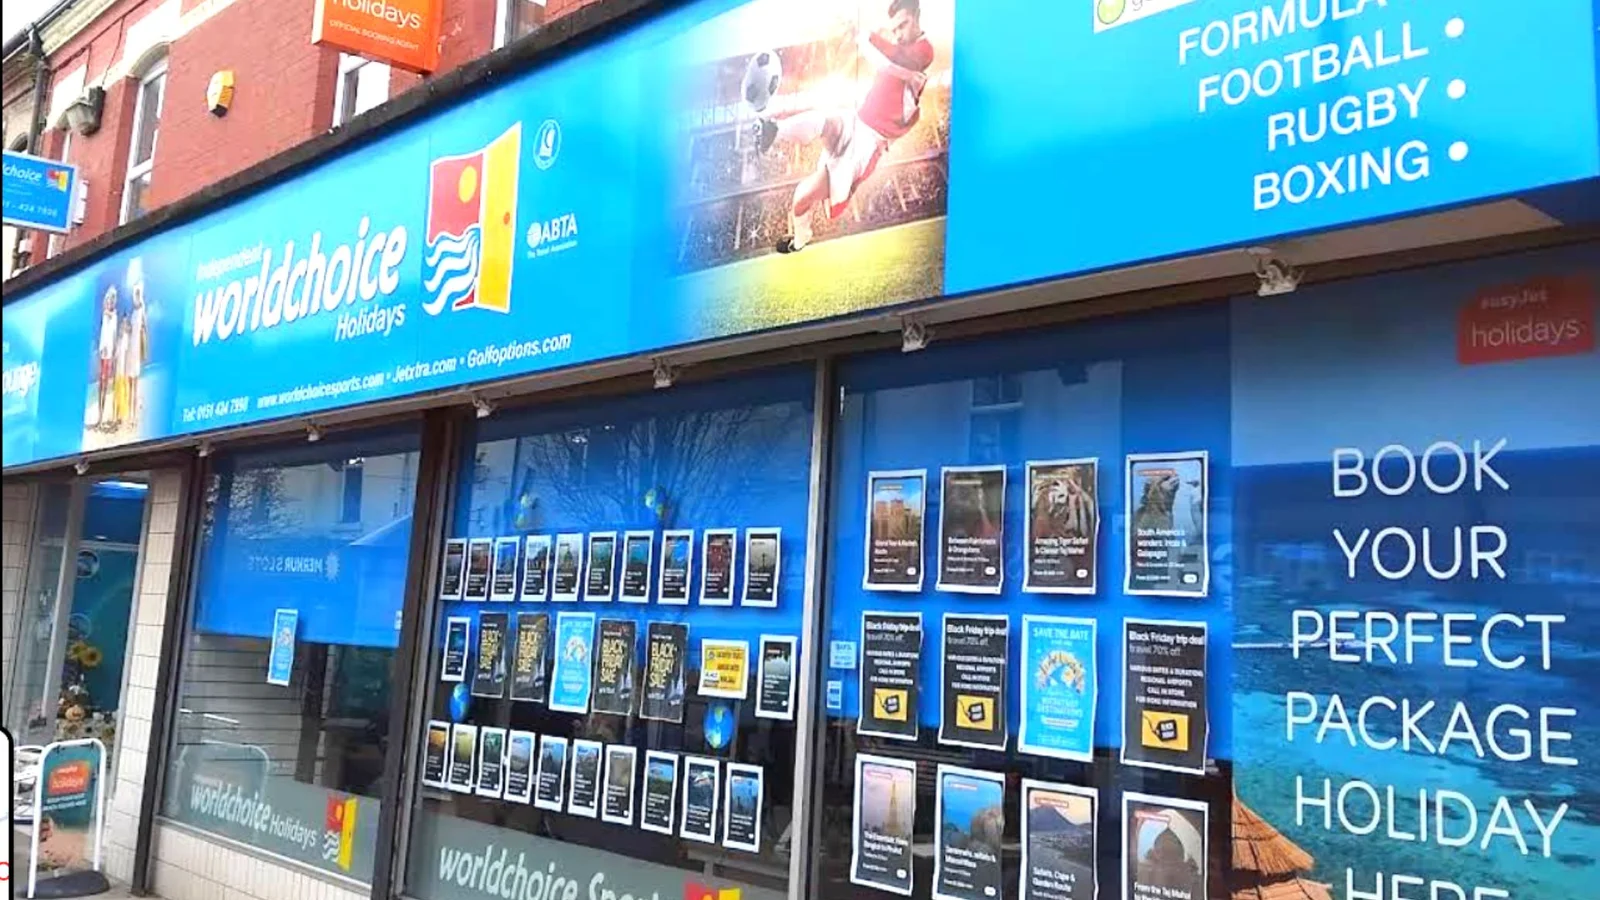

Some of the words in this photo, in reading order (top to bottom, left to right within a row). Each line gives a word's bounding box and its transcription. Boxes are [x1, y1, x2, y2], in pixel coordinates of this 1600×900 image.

[333, 0, 421, 29] olidays
[1197, 22, 1429, 114] FOOTBALL
[1267, 77, 1431, 152] RUGBY
[1253, 139, 1431, 211] BOXING
[540, 212, 578, 244] ABTA
[192, 216, 408, 346] worldchoice
[334, 302, 406, 342] Holidays
[1472, 316, 1580, 349] holidays
[467, 332, 572, 369] Golfoptions.com
[1333, 437, 1510, 497] BOOK
[1333, 525, 1509, 580] YOUR
[603, 639, 624, 654] BLACK
[866, 621, 882, 630] Black
[947, 624, 964, 633] Black
[1129, 631, 1149, 640] Black
[1150, 632, 1175, 645] Friday
[1175, 634, 1188, 646] trip
[1292, 609, 1566, 670] PERFECT
[651, 642, 675, 658] BLACK
[1286, 691, 1579, 766] PACKAGE
[191, 780, 272, 833] worldchoice
[269, 813, 318, 850] Holidays
[1296, 775, 1569, 858] HOLIDAY
[438, 844, 579, 900] worldchoice
[1346, 867, 1510, 900] HE
